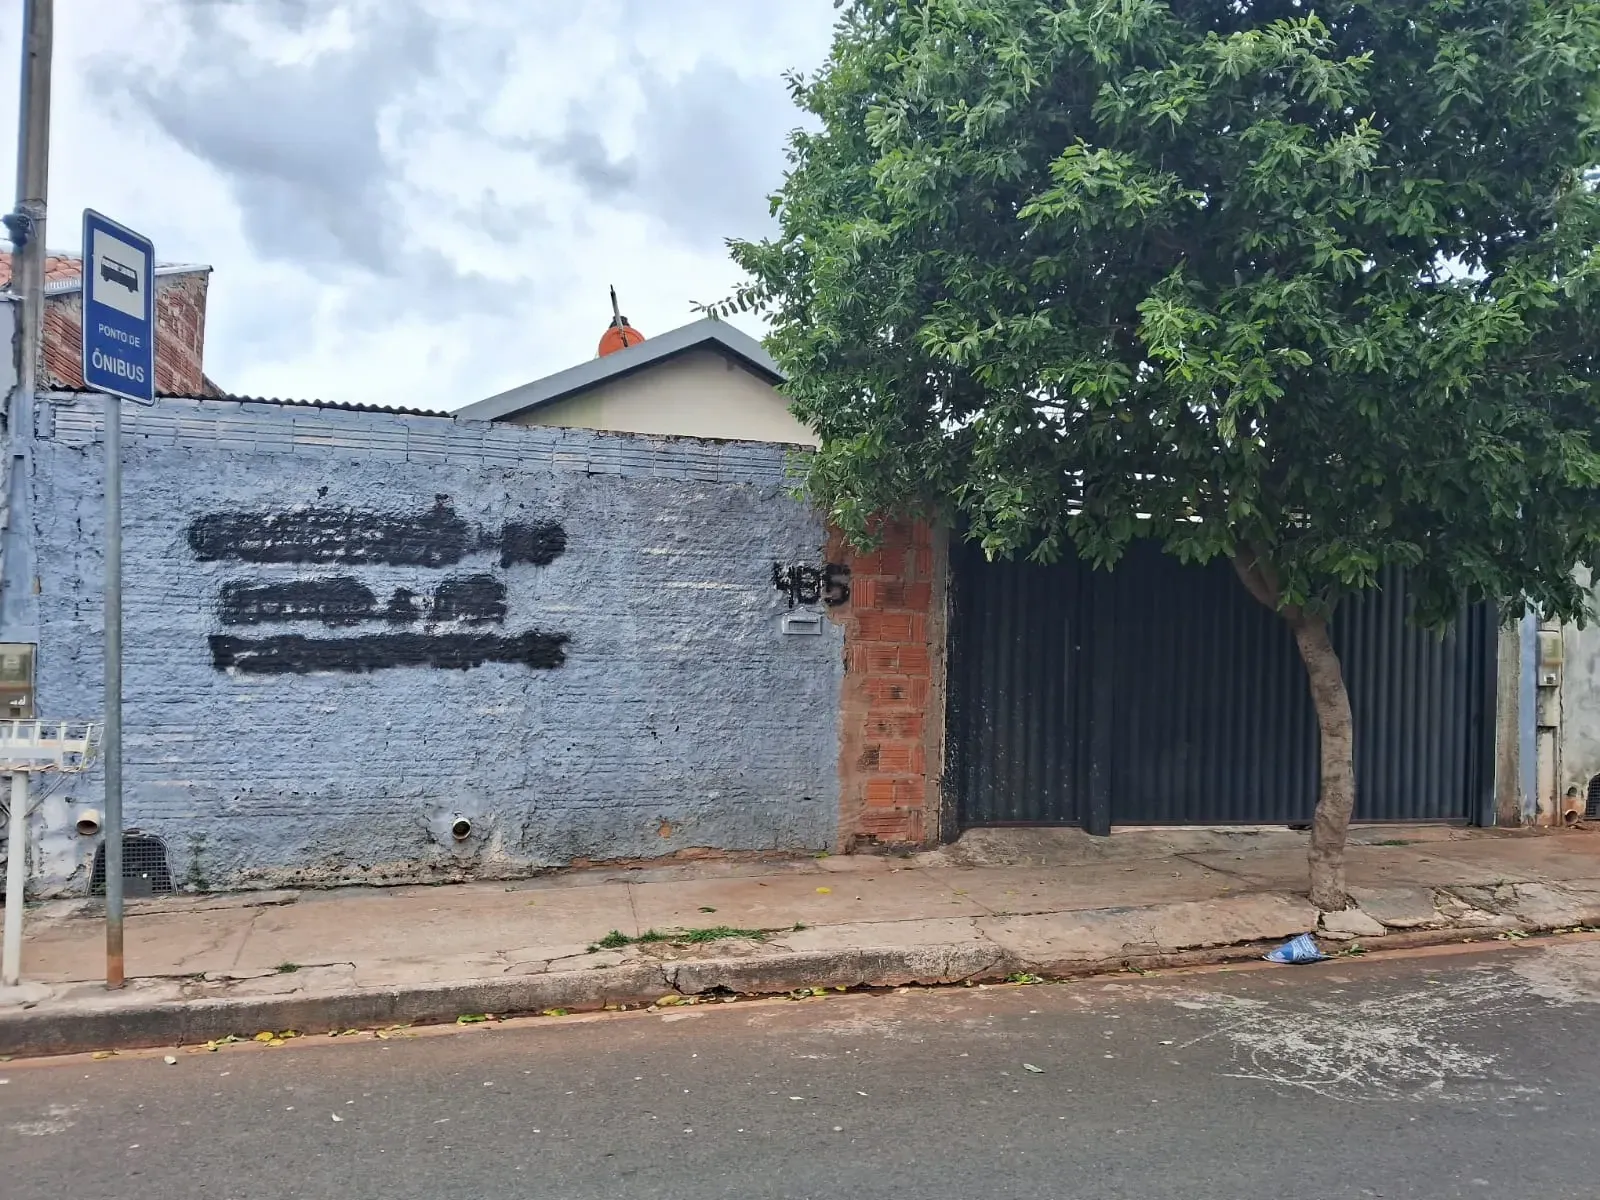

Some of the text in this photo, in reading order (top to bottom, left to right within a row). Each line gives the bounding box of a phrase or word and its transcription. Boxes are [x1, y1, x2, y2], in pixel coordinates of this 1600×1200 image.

[98, 323, 140, 348] PONTO DE
[92, 347, 145, 383] ÔNIBUS
